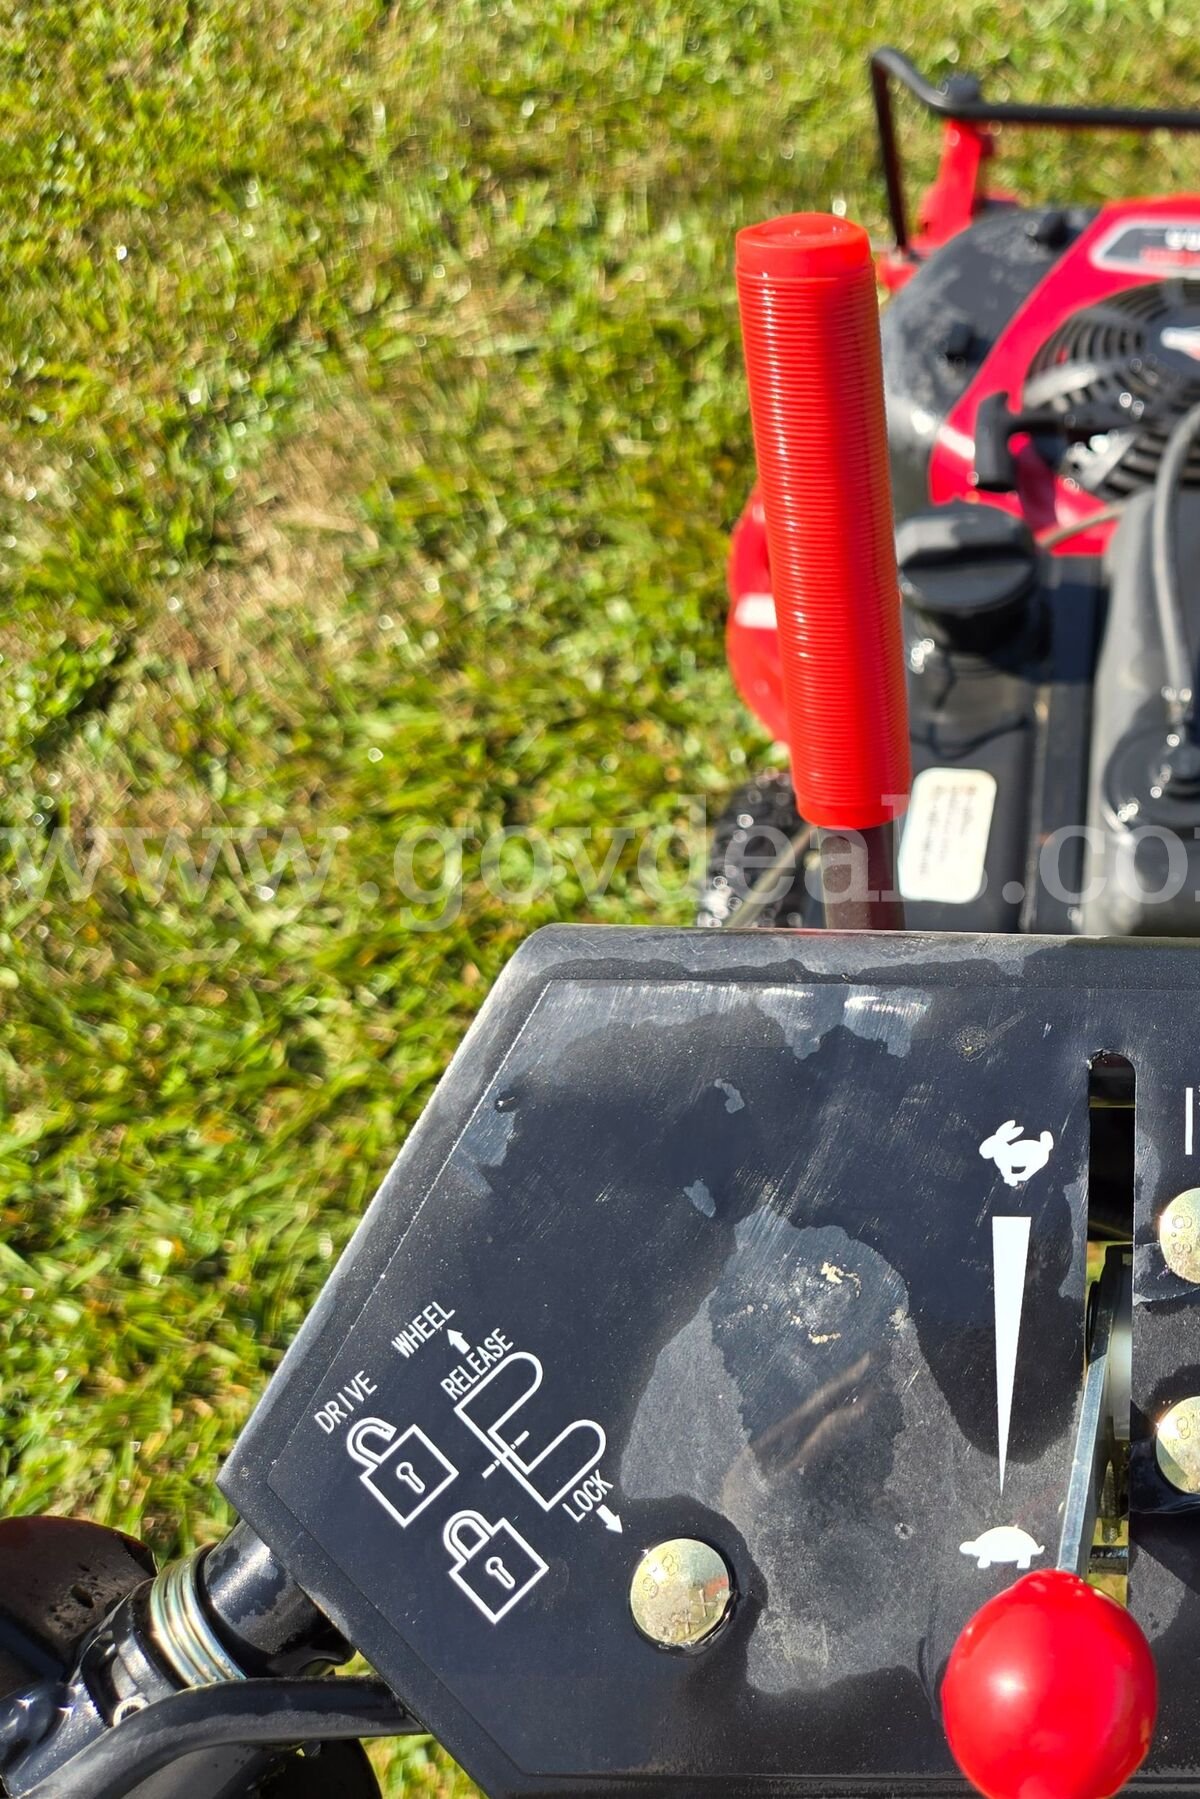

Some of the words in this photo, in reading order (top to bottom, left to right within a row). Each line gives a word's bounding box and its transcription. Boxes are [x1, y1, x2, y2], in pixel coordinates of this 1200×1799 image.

[391, 1301, 456, 1359] WHEEL
[440, 1328, 514, 1400] RELEASE
[313, 1370, 378, 1434] DRIVE
[562, 1469, 614, 1522] LOCK
